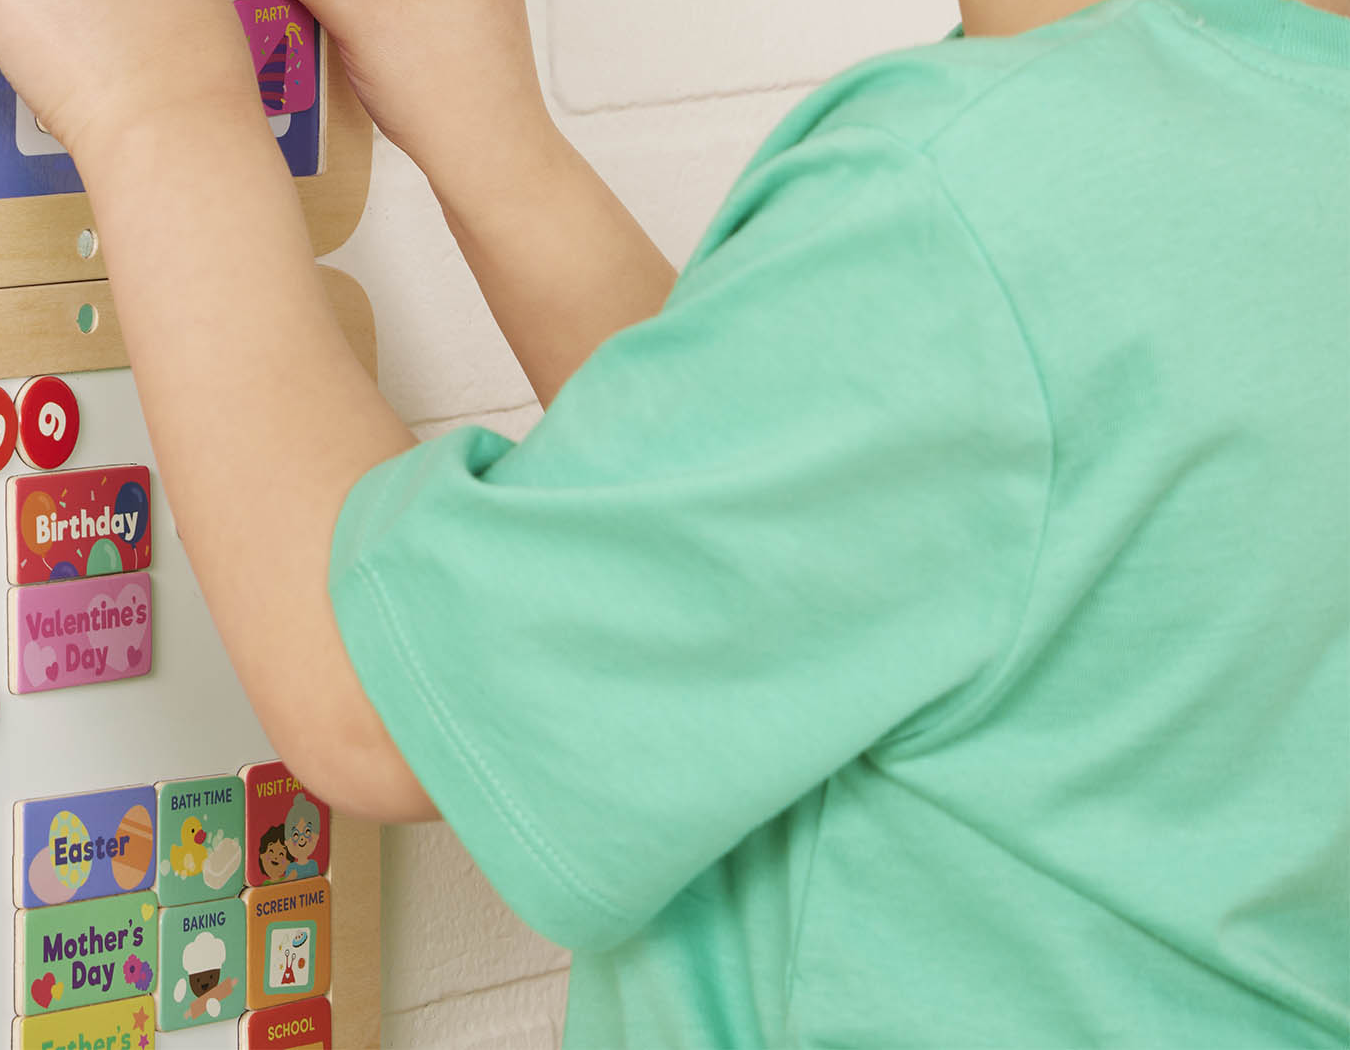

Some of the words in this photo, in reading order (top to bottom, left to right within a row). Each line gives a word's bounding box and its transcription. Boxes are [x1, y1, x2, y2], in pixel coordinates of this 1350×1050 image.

[255, 5, 290, 23] PARTY
[35, 505, 138, 544] Birthday
[25, 596, 147, 641] Valentine's
[65, 641, 107, 675] Day
[171, 793, 201, 810] BATH
[204, 788, 232, 806] TIME
[256, 779, 284, 798] VISIT
[54, 832, 130, 866] Easter
[256, 898, 297, 917] SCREEN
[299, 890, 325, 906] TIME
[183, 911, 226, 932] BAKING
[42, 920, 144, 963] Mother's
[71, 961, 115, 991] Day
[267, 1017, 315, 1041] SCHOOL
